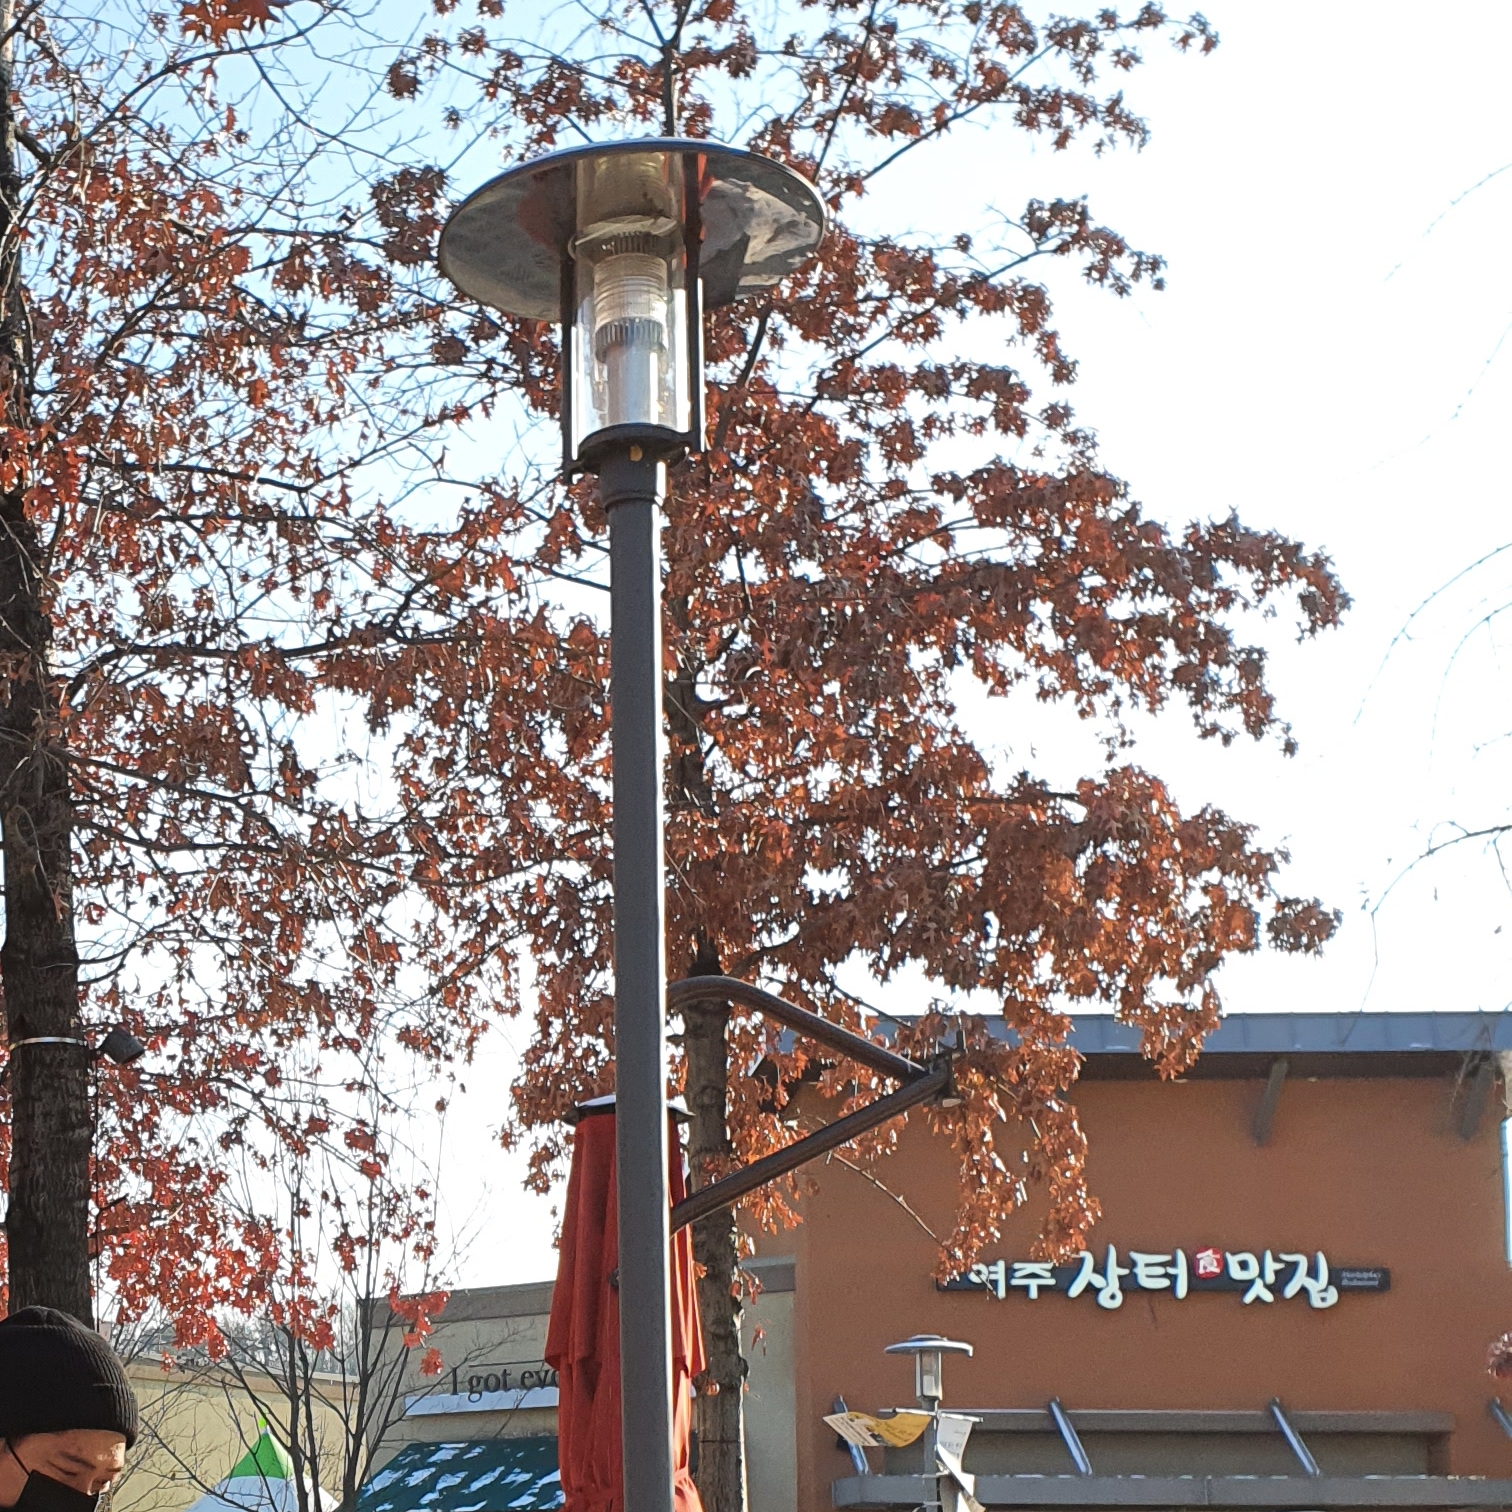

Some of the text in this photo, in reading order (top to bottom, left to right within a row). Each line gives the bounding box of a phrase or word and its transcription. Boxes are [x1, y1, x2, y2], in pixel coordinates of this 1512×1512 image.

[967, 1259, 1057, 1300] 여주
[1067, 1243, 1188, 1310] 장터
[1225, 1249, 1339, 1309] 맛집
[450, 1366, 460, 1396] I
[467, 1368, 512, 1403] got
